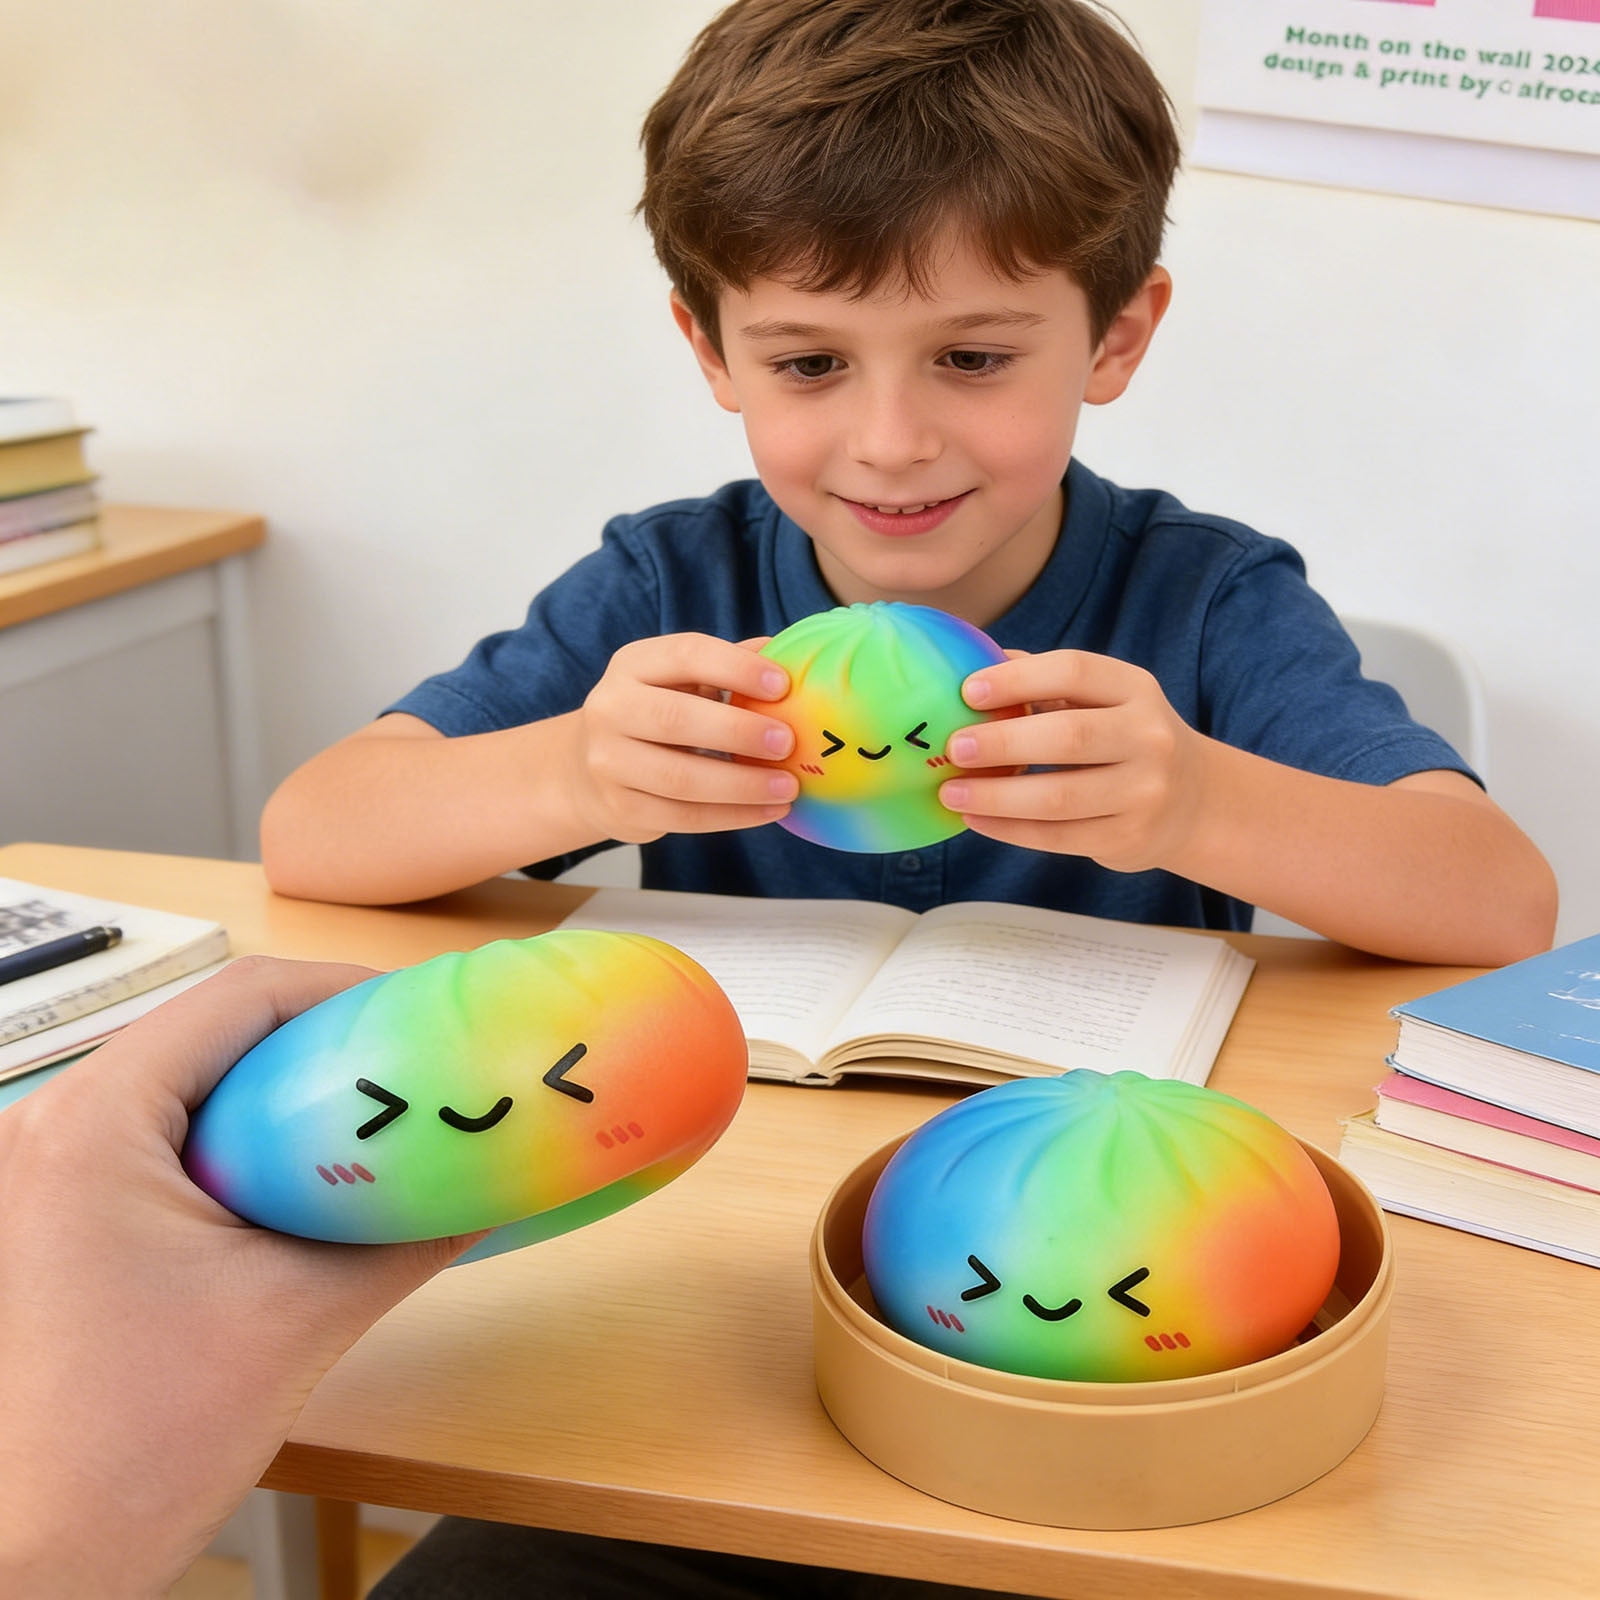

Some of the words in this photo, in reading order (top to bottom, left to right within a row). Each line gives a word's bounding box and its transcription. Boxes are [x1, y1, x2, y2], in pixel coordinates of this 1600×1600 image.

[1285, 25, 1369, 50] Month
[1379, 39, 1411, 55] on
[1423, 40, 1467, 61] the
[1478, 49, 1531, 69] wall
[1379, 68, 1449, 88] print
[1459, 74, 1492, 99] by
